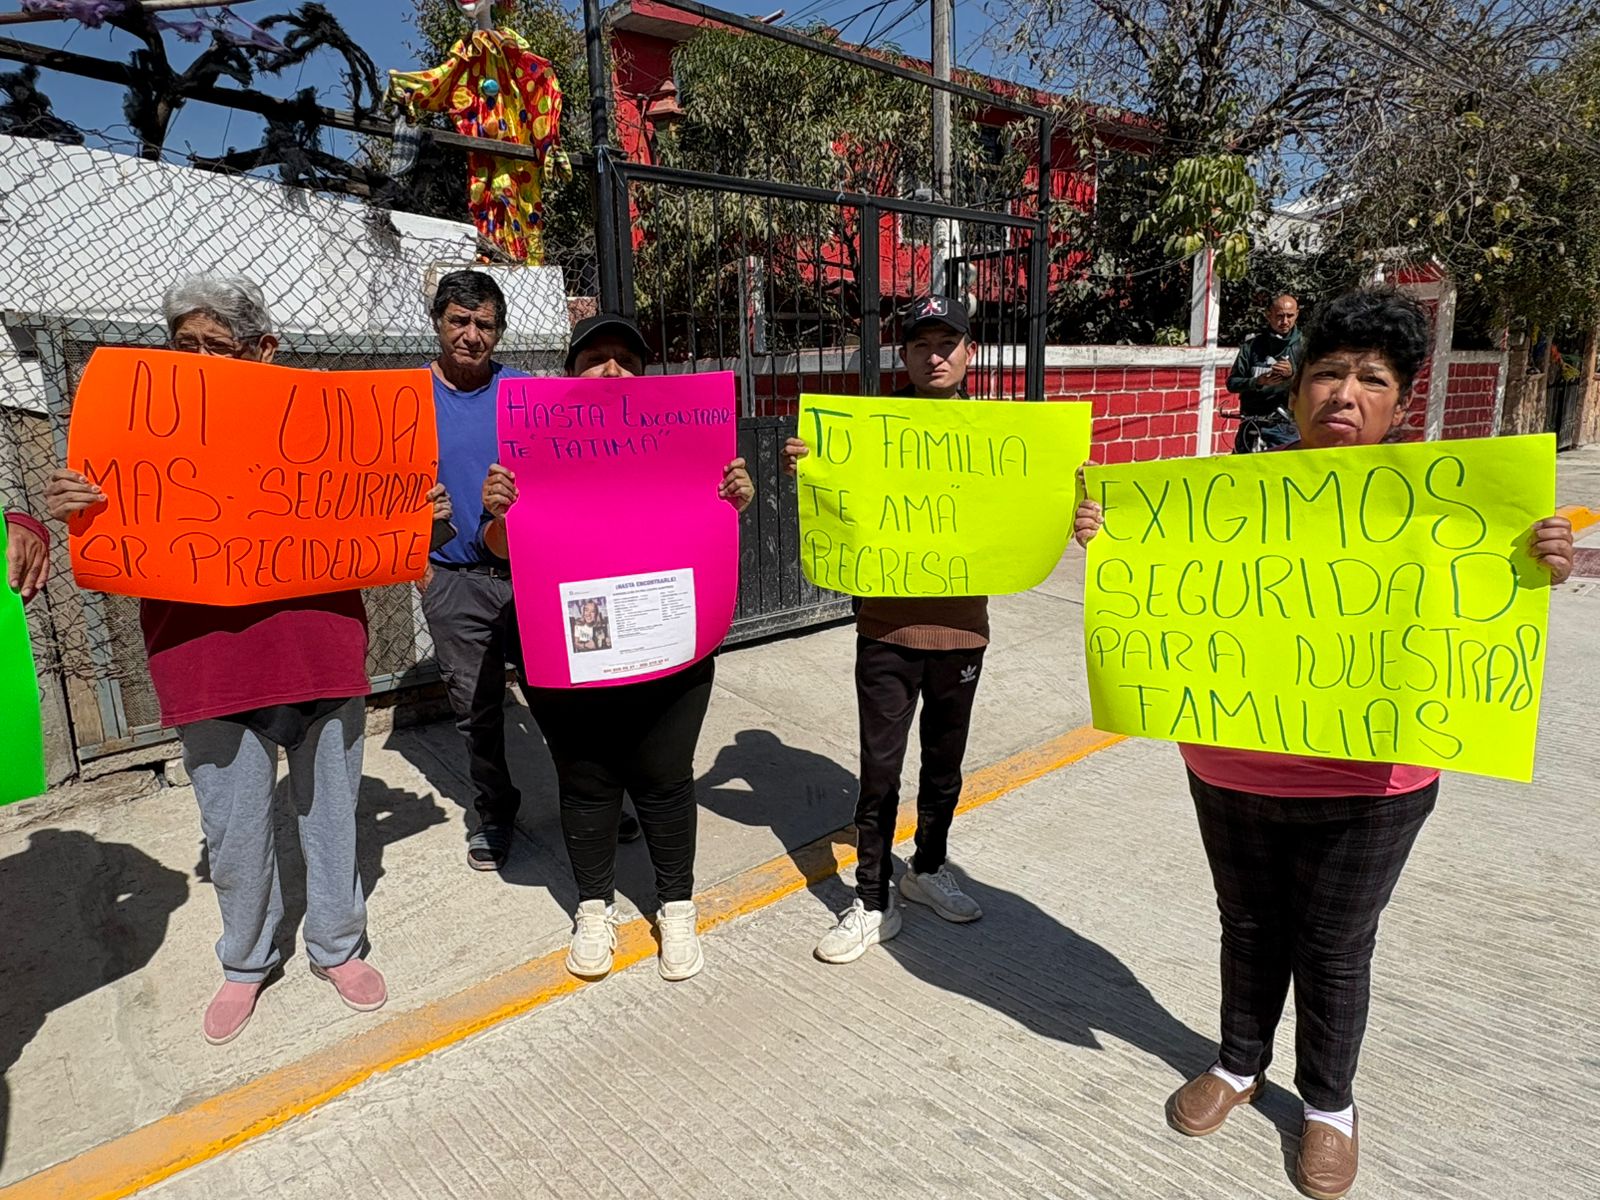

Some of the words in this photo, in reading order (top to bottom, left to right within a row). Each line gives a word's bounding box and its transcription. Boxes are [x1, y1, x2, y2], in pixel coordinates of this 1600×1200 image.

[128, 360, 207, 447] NI
[278, 384, 420, 467] UNA
[505, 384, 606, 429] HASTA
[804, 406, 853, 465] TU
[869, 413, 1027, 477] FAMILIA
[501, 440, 533, 459] TE
[1100, 455, 1488, 550] EXIGIMOS
[169, 529, 428, 588] PRECIDENTE
[1096, 551, 1521, 623] SEGURIDAD
[1089, 625, 1247, 678] PARA
[1295, 623, 1541, 712] NUESTRAS
[1118, 684, 1463, 760] FAMILIAS
